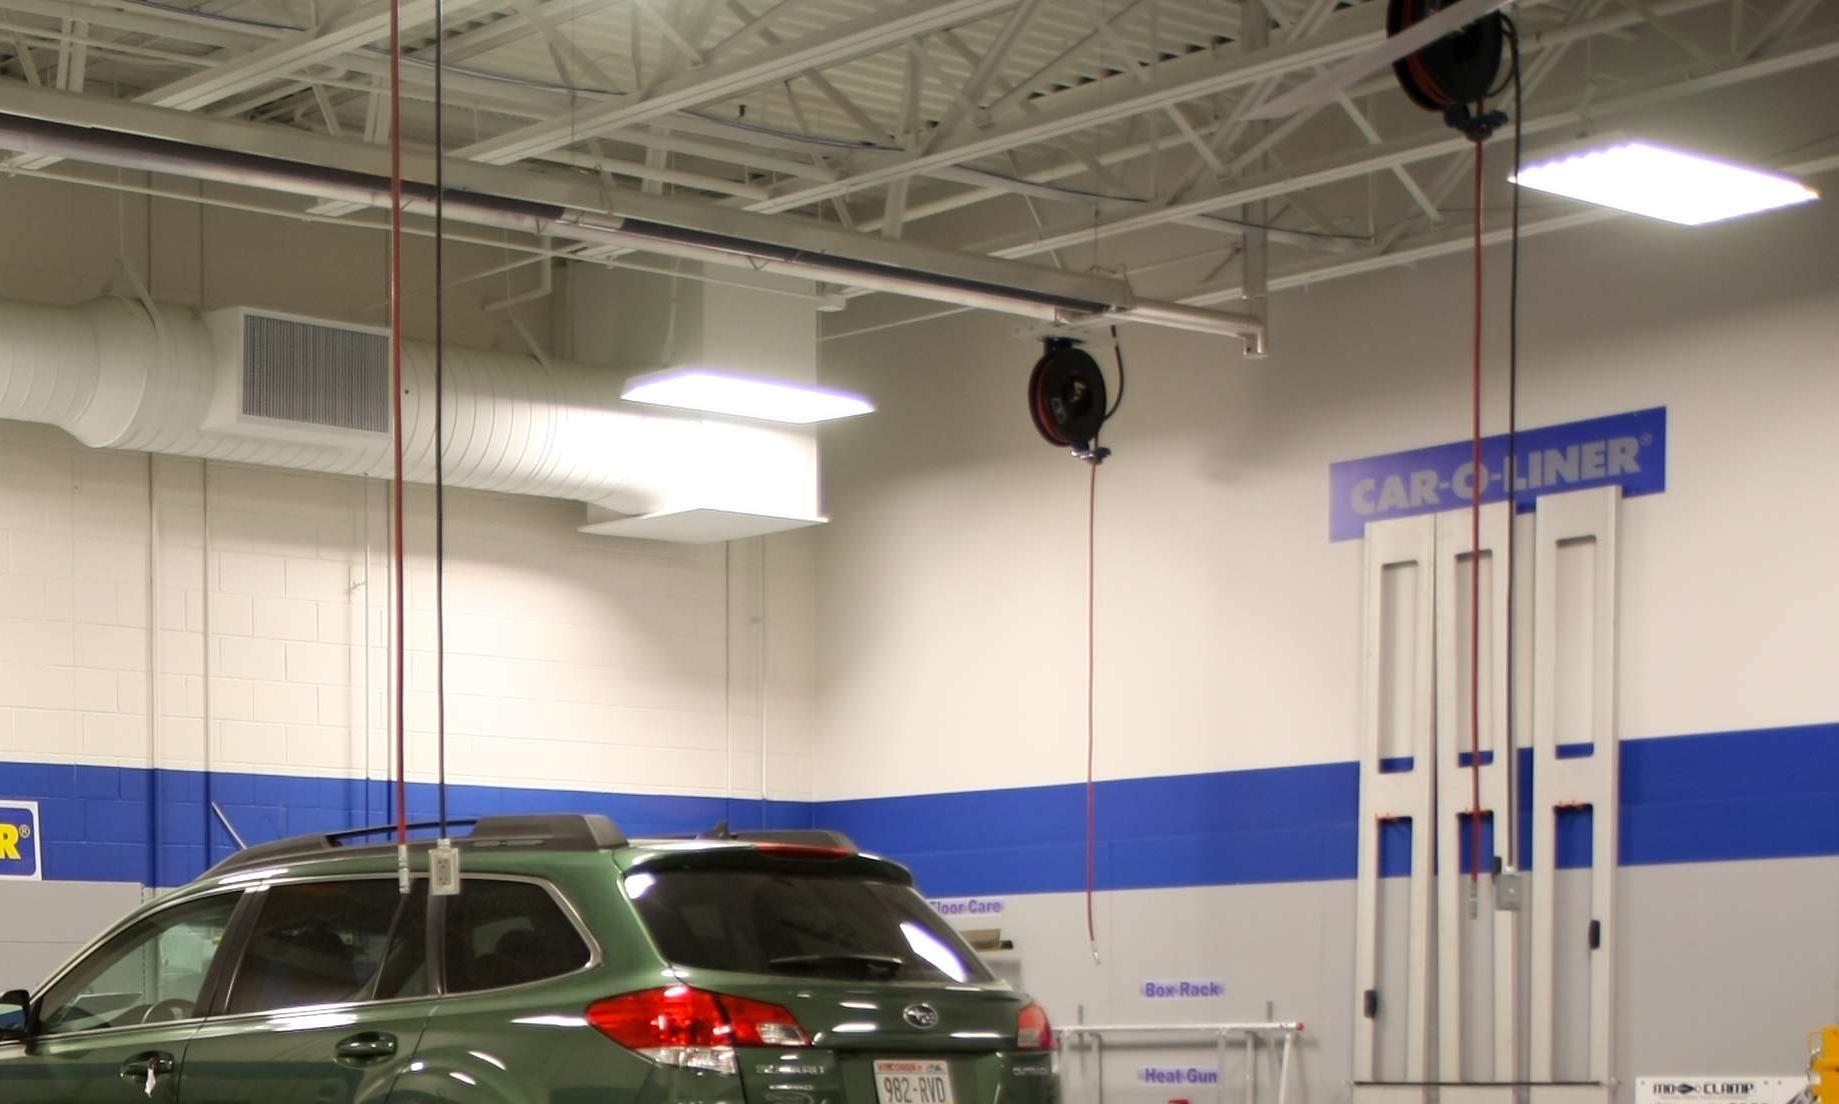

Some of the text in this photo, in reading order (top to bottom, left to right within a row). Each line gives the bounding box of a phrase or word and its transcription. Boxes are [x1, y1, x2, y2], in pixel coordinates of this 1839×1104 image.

[969, 899, 1003, 913] Care
[1145, 981, 1219, 997] Box Rack
[1145, 1068, 1217, 1083] Heat Gun
[884, 1077, 946, 1103] 982-RVD
